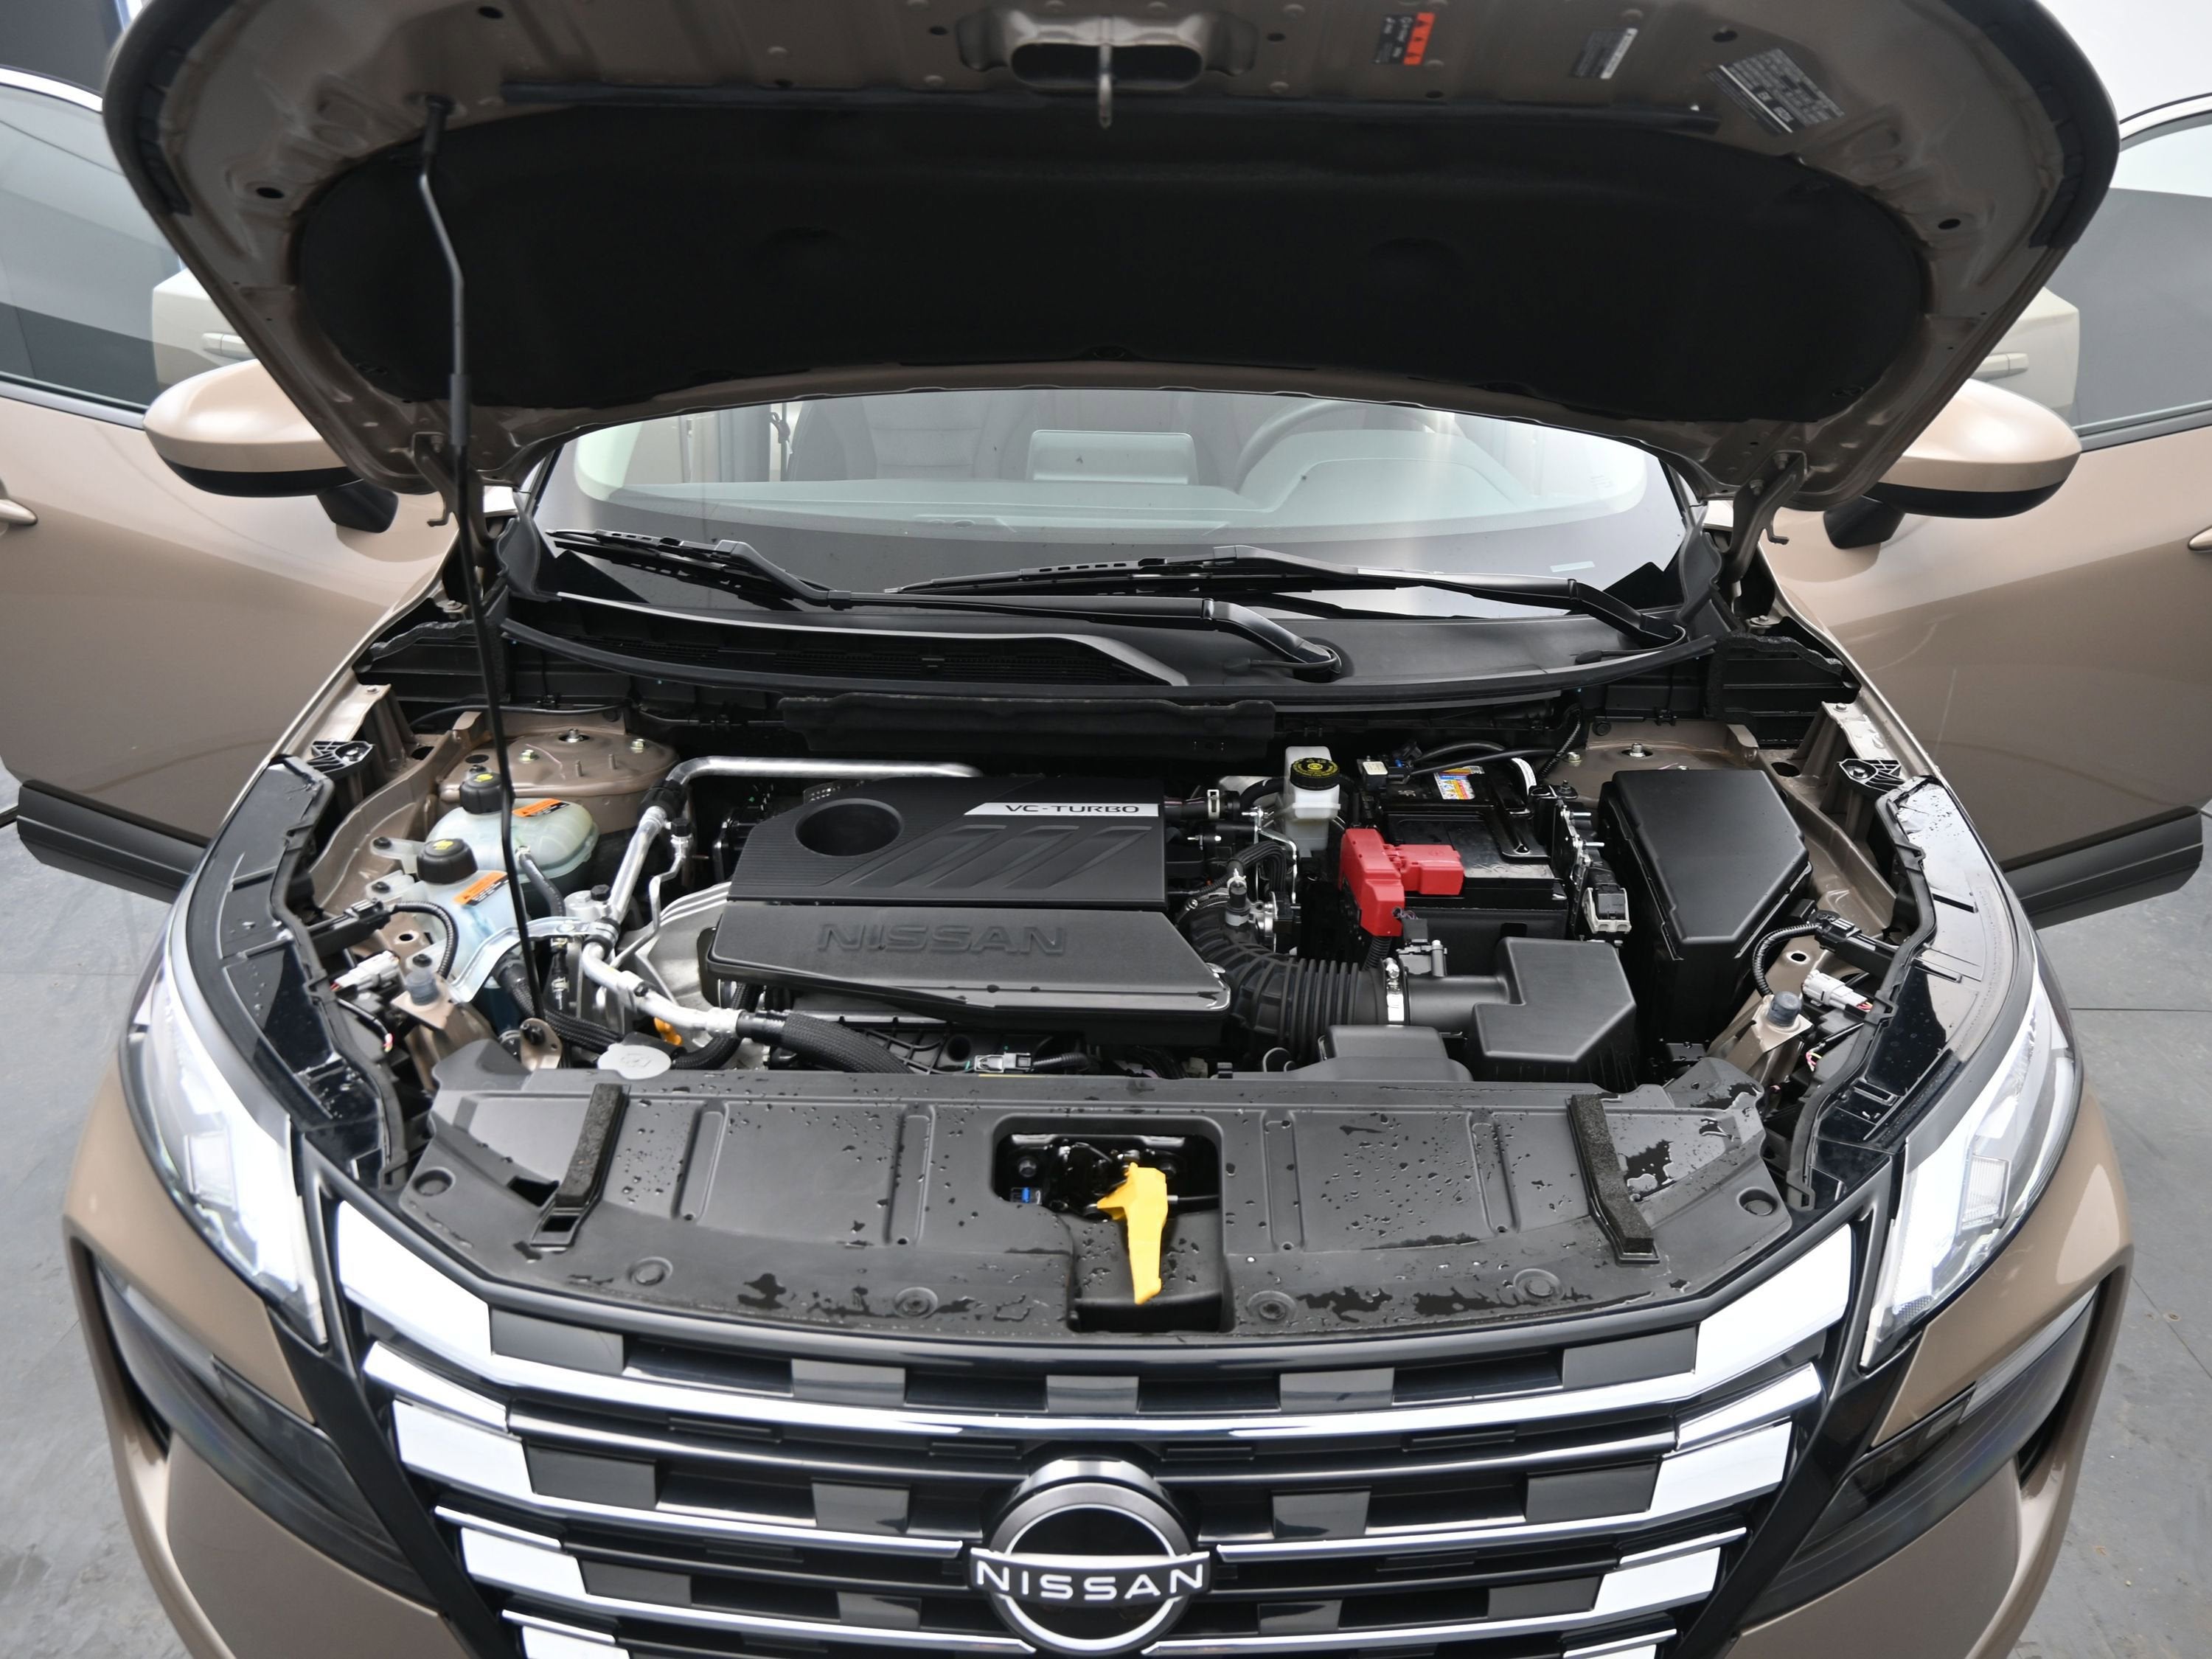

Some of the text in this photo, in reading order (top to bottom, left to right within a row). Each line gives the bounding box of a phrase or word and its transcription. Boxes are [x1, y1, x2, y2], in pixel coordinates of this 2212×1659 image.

[1005, 804, 1140, 814] VC-TURBO
[818, 923, 1065, 956] NISSAN
[977, 1559, 1203, 1601] NISSAN
